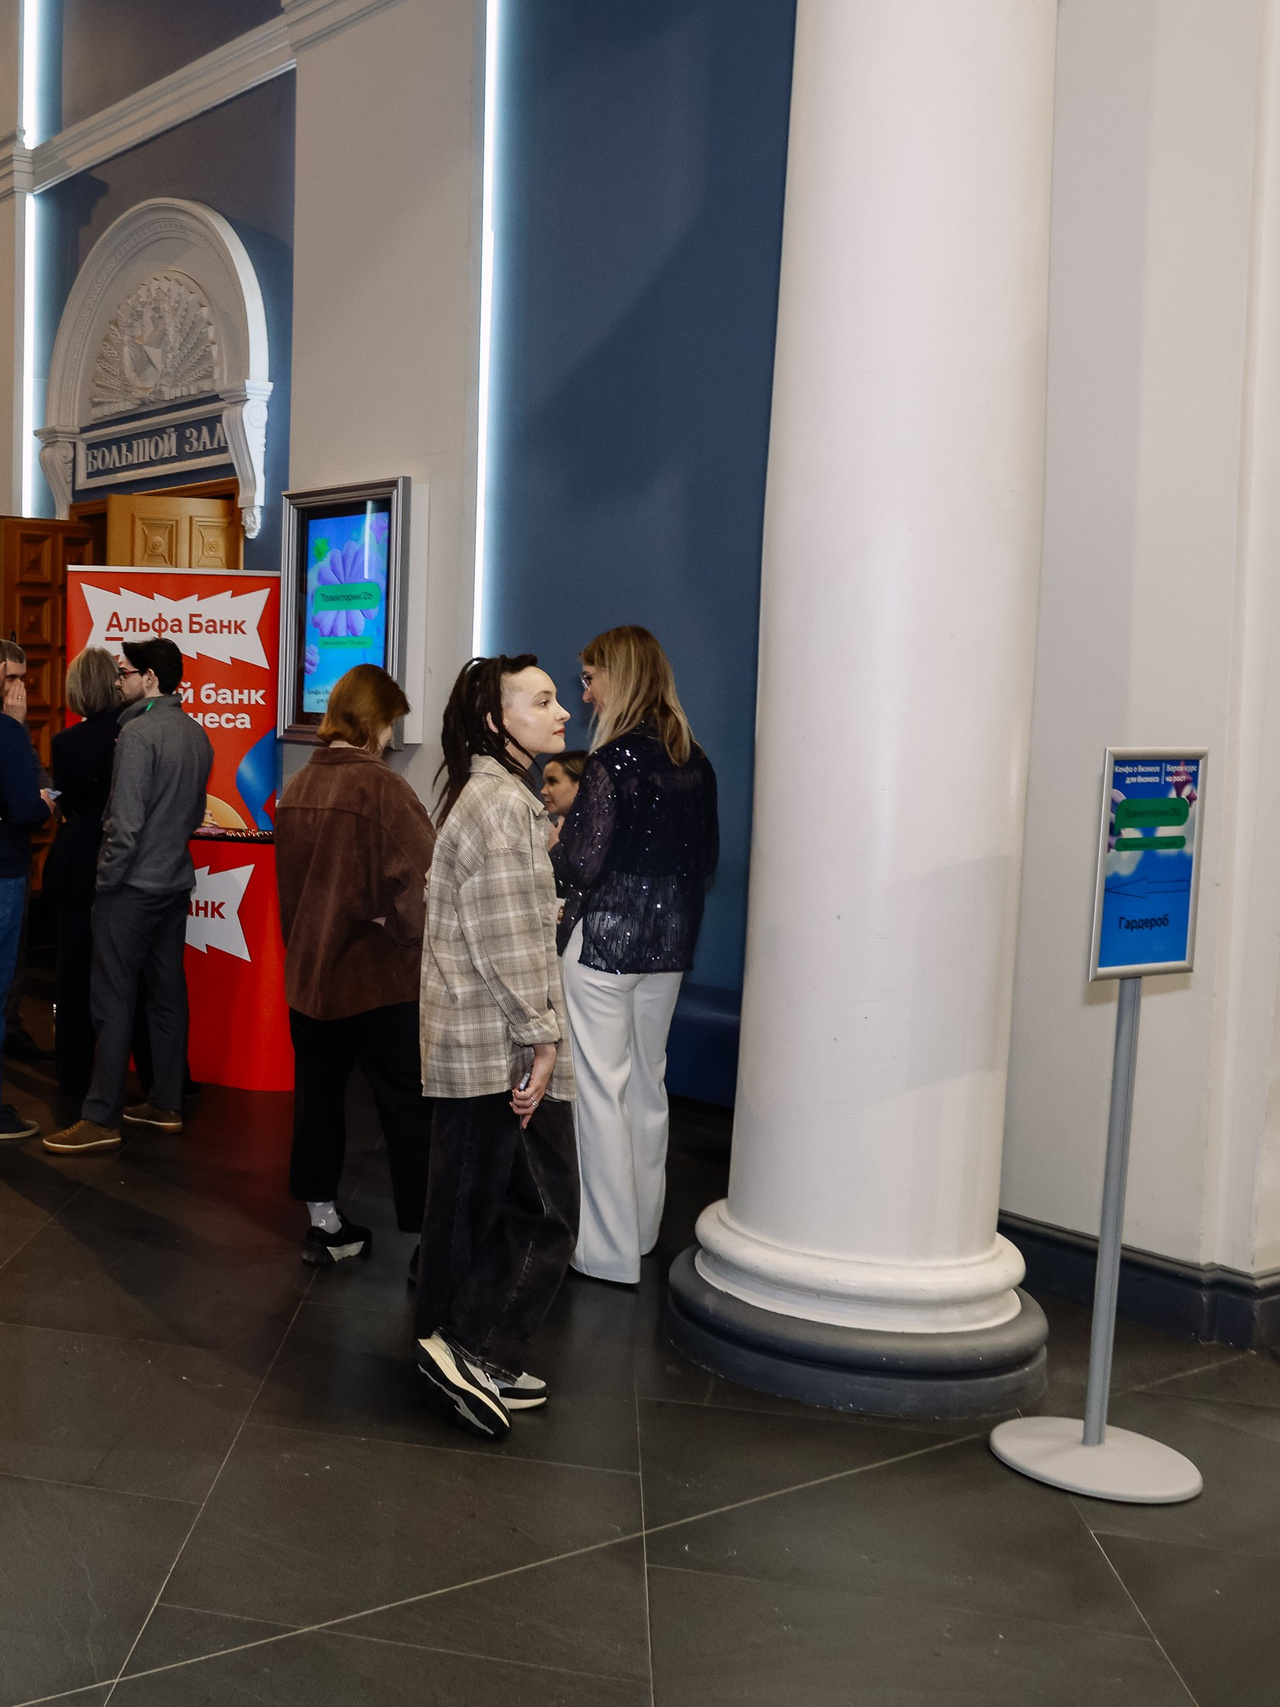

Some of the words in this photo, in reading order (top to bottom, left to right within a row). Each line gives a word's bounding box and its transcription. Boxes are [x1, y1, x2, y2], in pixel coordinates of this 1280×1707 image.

[86, 427, 179, 473] БОЛЬШОЙ
[184, 422, 228, 453] ЗАЛ
[105, 612, 183, 639] Альфа
[188, 613, 247, 635] Банк
[200, 682, 267, 706] банк
[188, 711, 252, 730] неса
[187, 899, 226, 920] нк
[1118, 913, 1170, 931] Гардероб
